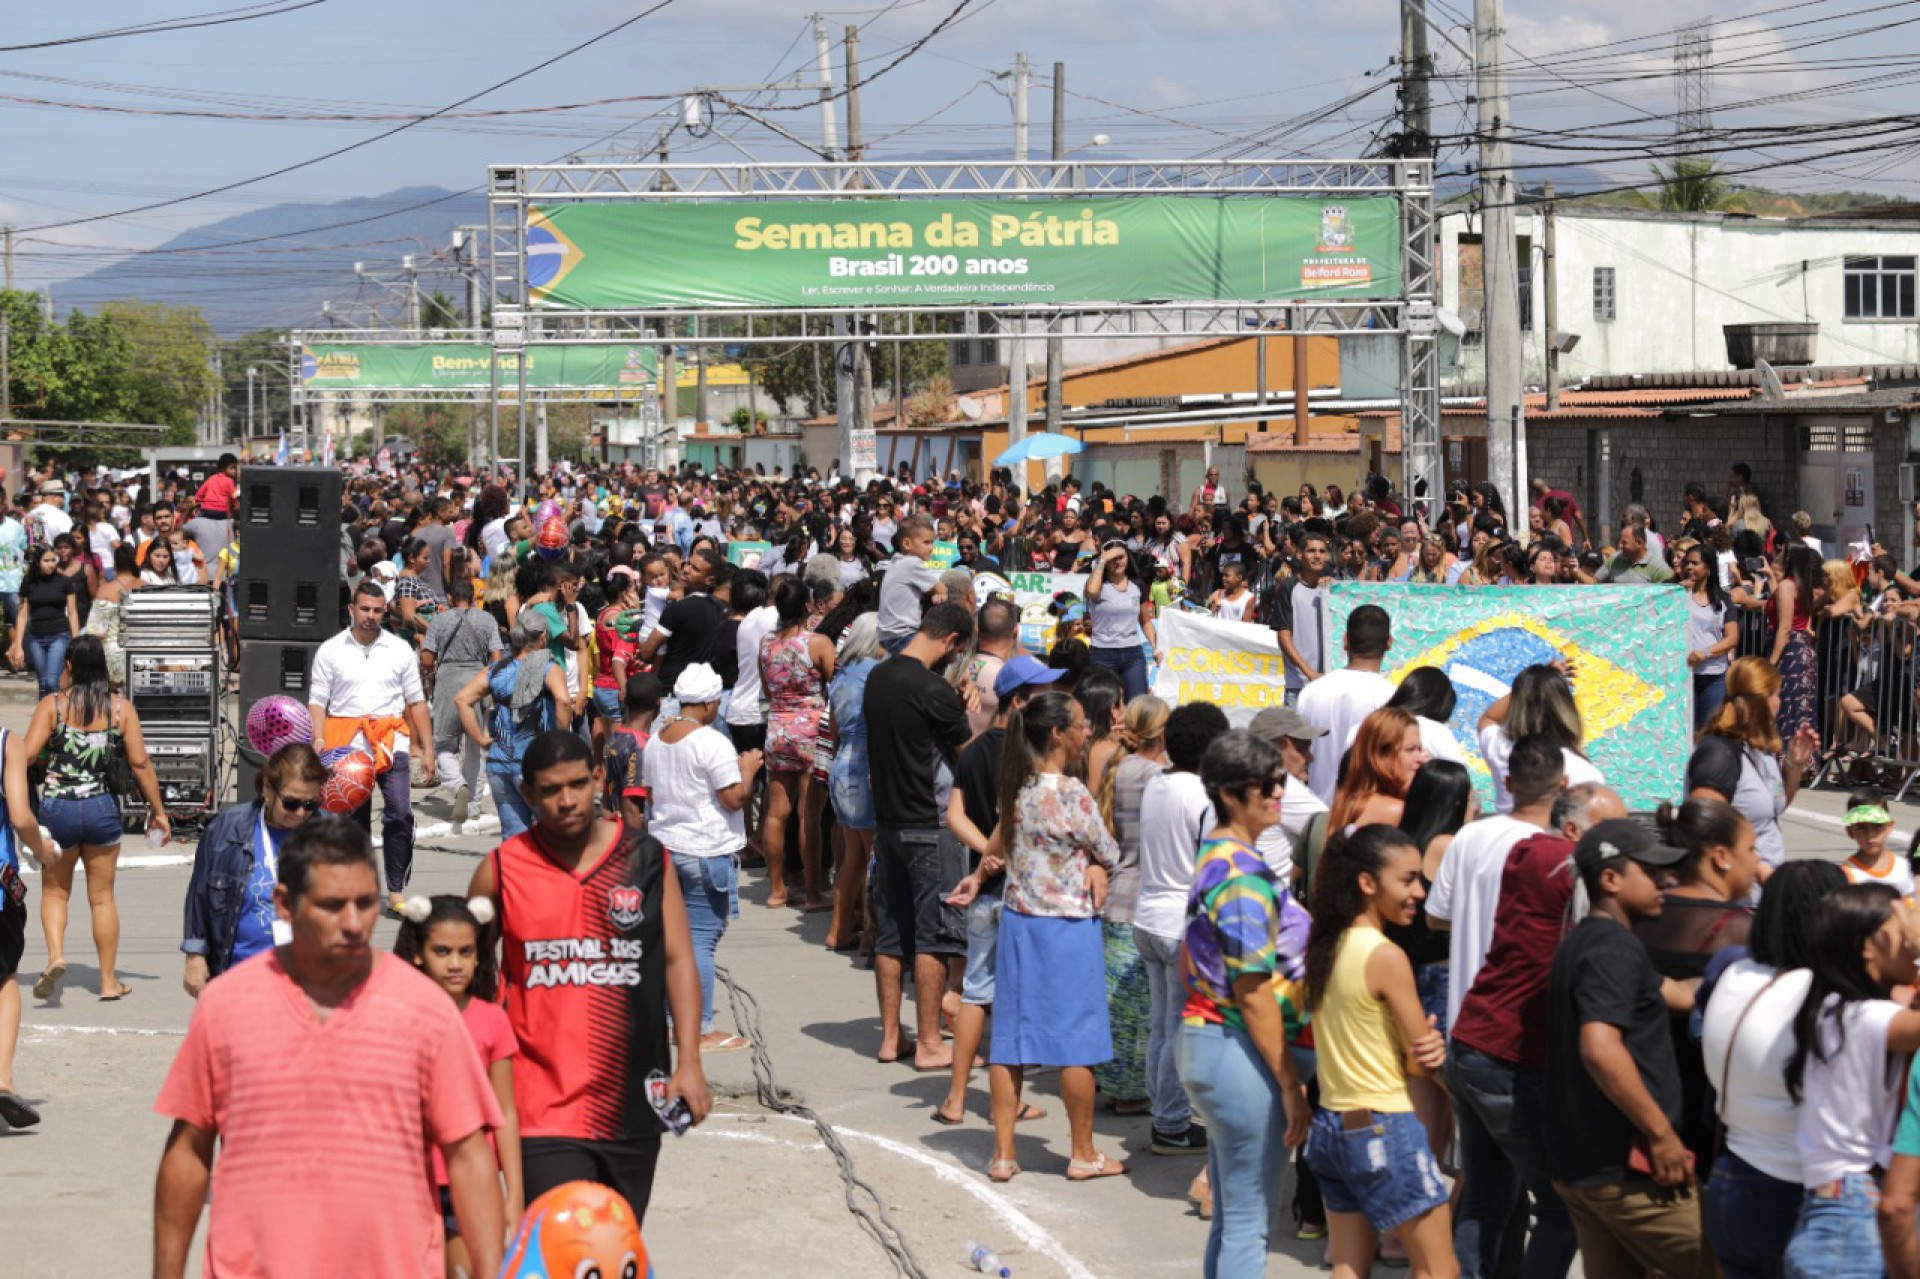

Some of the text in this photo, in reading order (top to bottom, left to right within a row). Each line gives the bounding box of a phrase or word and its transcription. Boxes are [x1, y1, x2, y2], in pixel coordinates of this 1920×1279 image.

[735, 208, 1119, 250] Semana da Pátria
[829, 253, 1029, 277] Brasil 200 anos
[1304, 267, 1340, 278] Belford
[821, 284, 864, 295] Escrever
[866, 286, 873, 295] e
[914, 283, 923, 293] A
[925, 283, 977, 293] Verdadeira
[980, 281, 1056, 293] Independência
[431, 355, 535, 370] Bem-vnd!
[524, 938, 607, 962] FESTIVAL
[526, 961, 642, 989] AMIGOS
